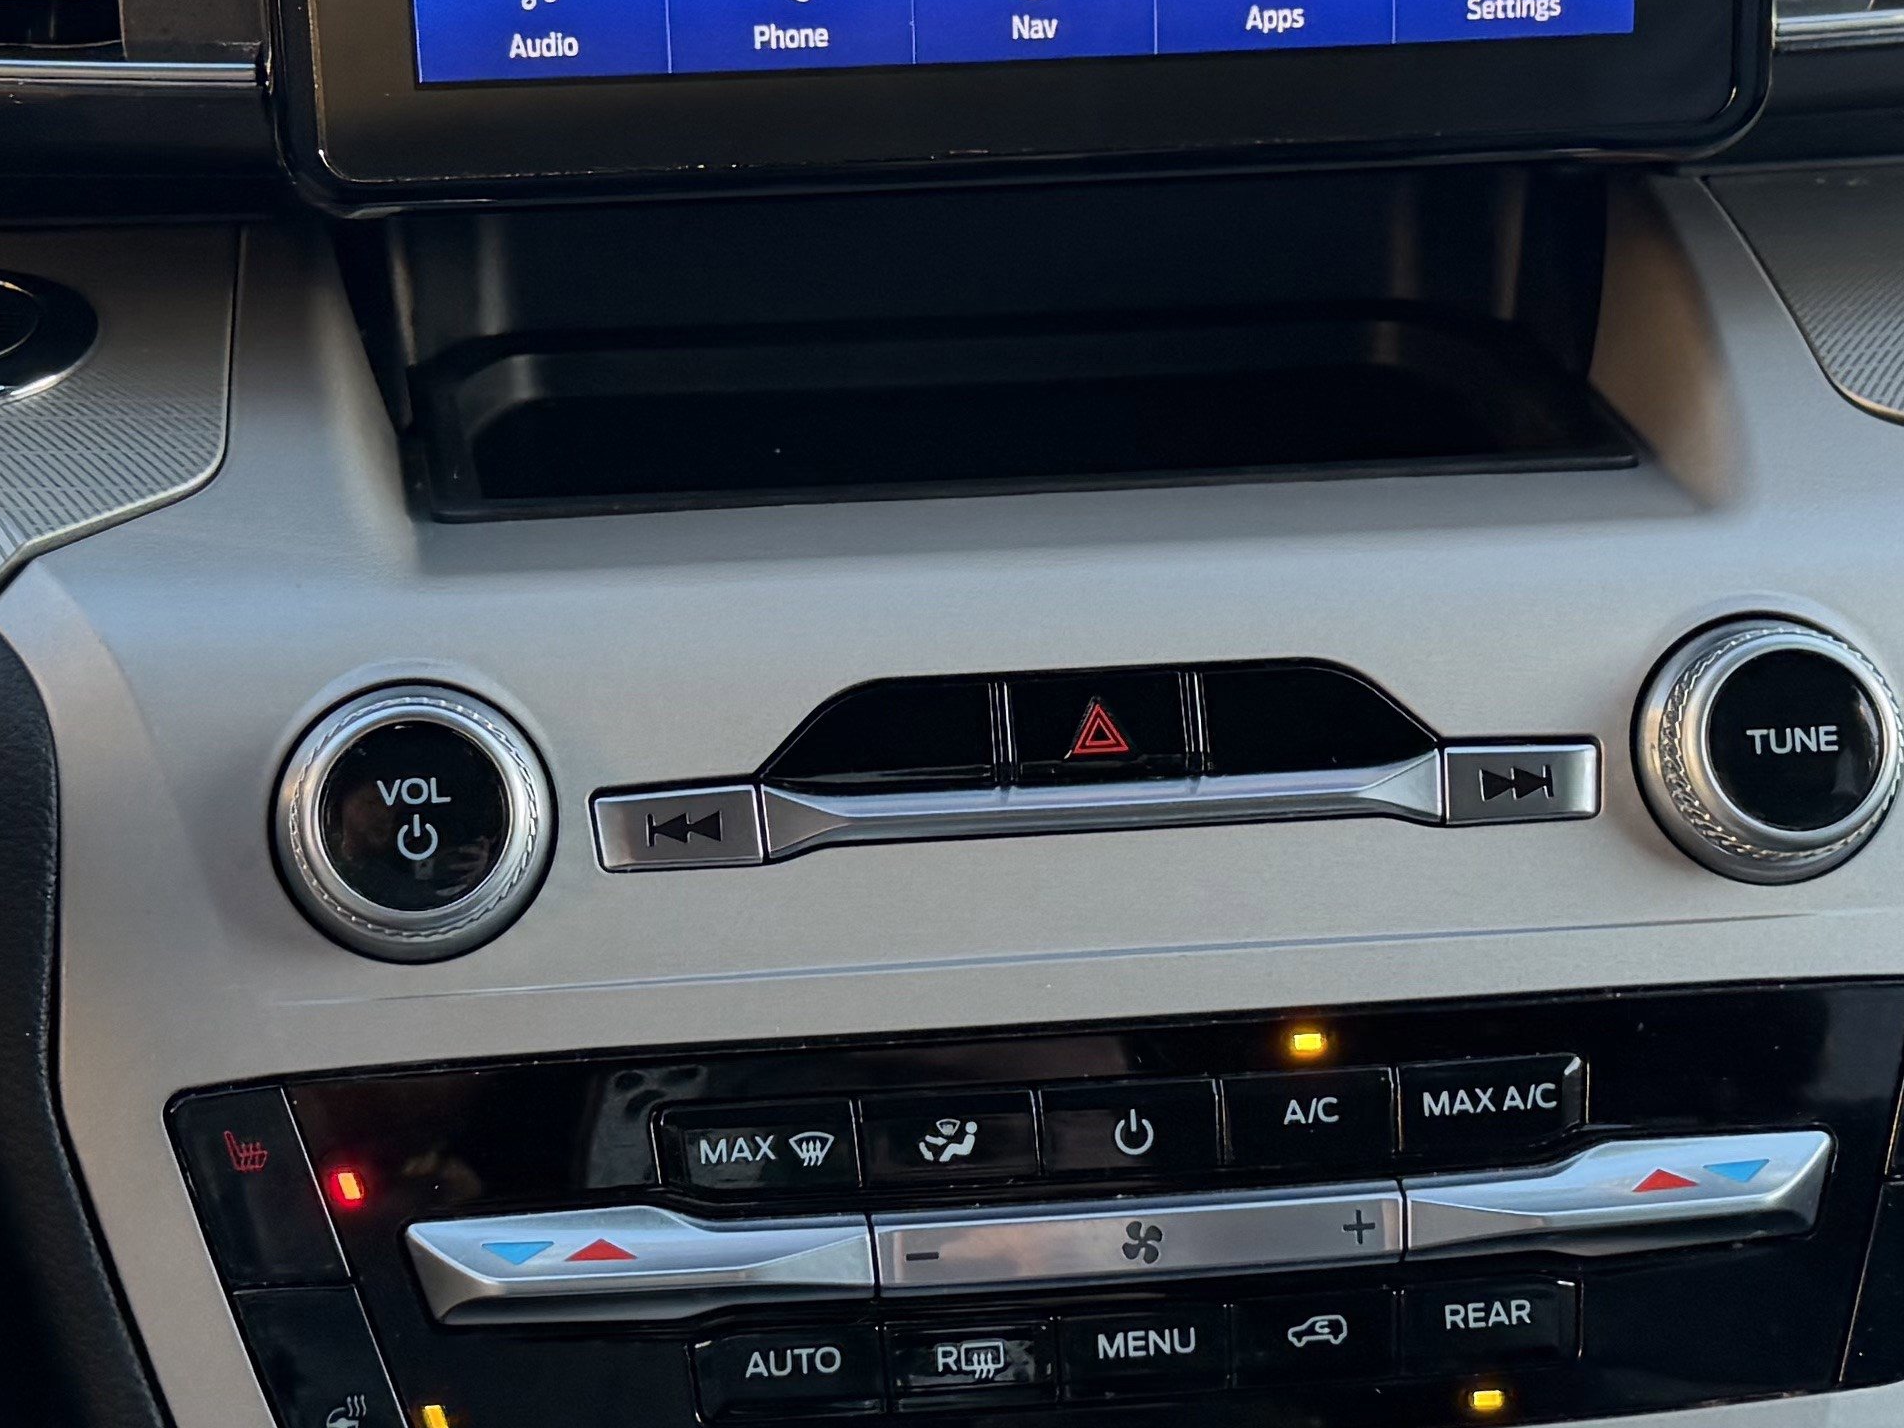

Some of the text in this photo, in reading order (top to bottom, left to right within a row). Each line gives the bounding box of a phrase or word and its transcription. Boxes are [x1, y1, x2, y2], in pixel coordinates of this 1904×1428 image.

[1012, 14, 1058, 40] Nav
[1245, 3, 1305, 34] Apps
[509, 33, 579, 60] Audio
[753, 25, 829, 51] Phone
[1746, 725, 1839, 755] TUNE
[377, 777, 451, 806] VOL
[1283, 1096, 1340, 1126] A/C
[1422, 1082, 1558, 1118] MAX A/C
[699, 1134, 777, 1166] MAX
[1444, 1298, 1532, 1330] REAR
[1096, 1326, 1197, 1360] MENU
[745, 1346, 842, 1378] AUTO
